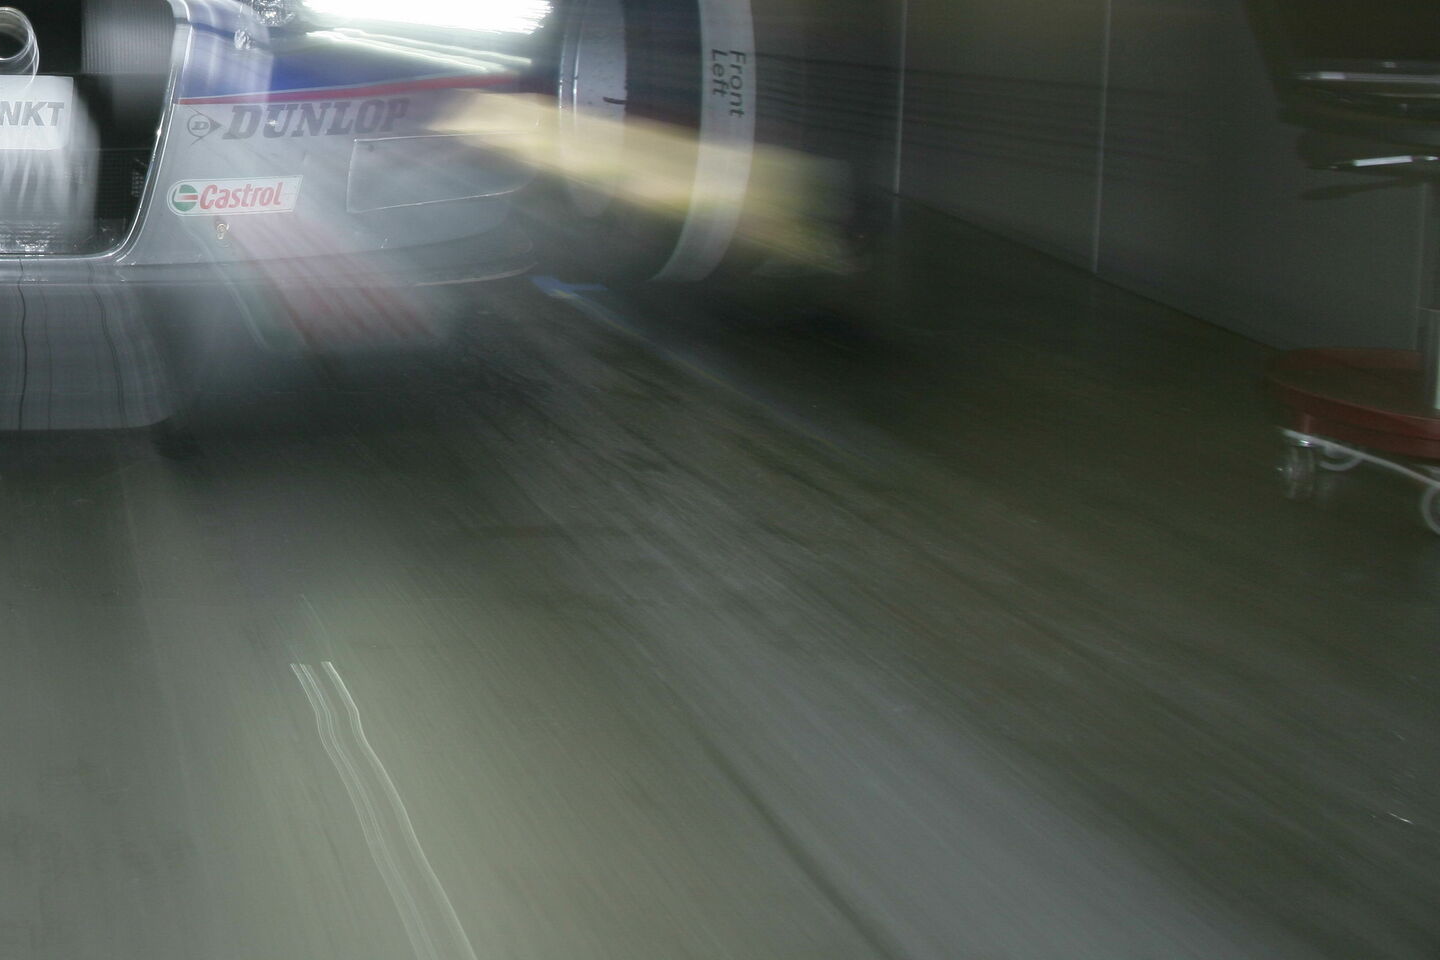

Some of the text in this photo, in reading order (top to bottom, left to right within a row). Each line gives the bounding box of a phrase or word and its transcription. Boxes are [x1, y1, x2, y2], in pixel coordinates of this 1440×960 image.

[711, 48, 728, 97] Left
[729, 50, 747, 119] Front
[222, 97, 411, 140] DUNLOP
[199, 181, 284, 210] Castrol
